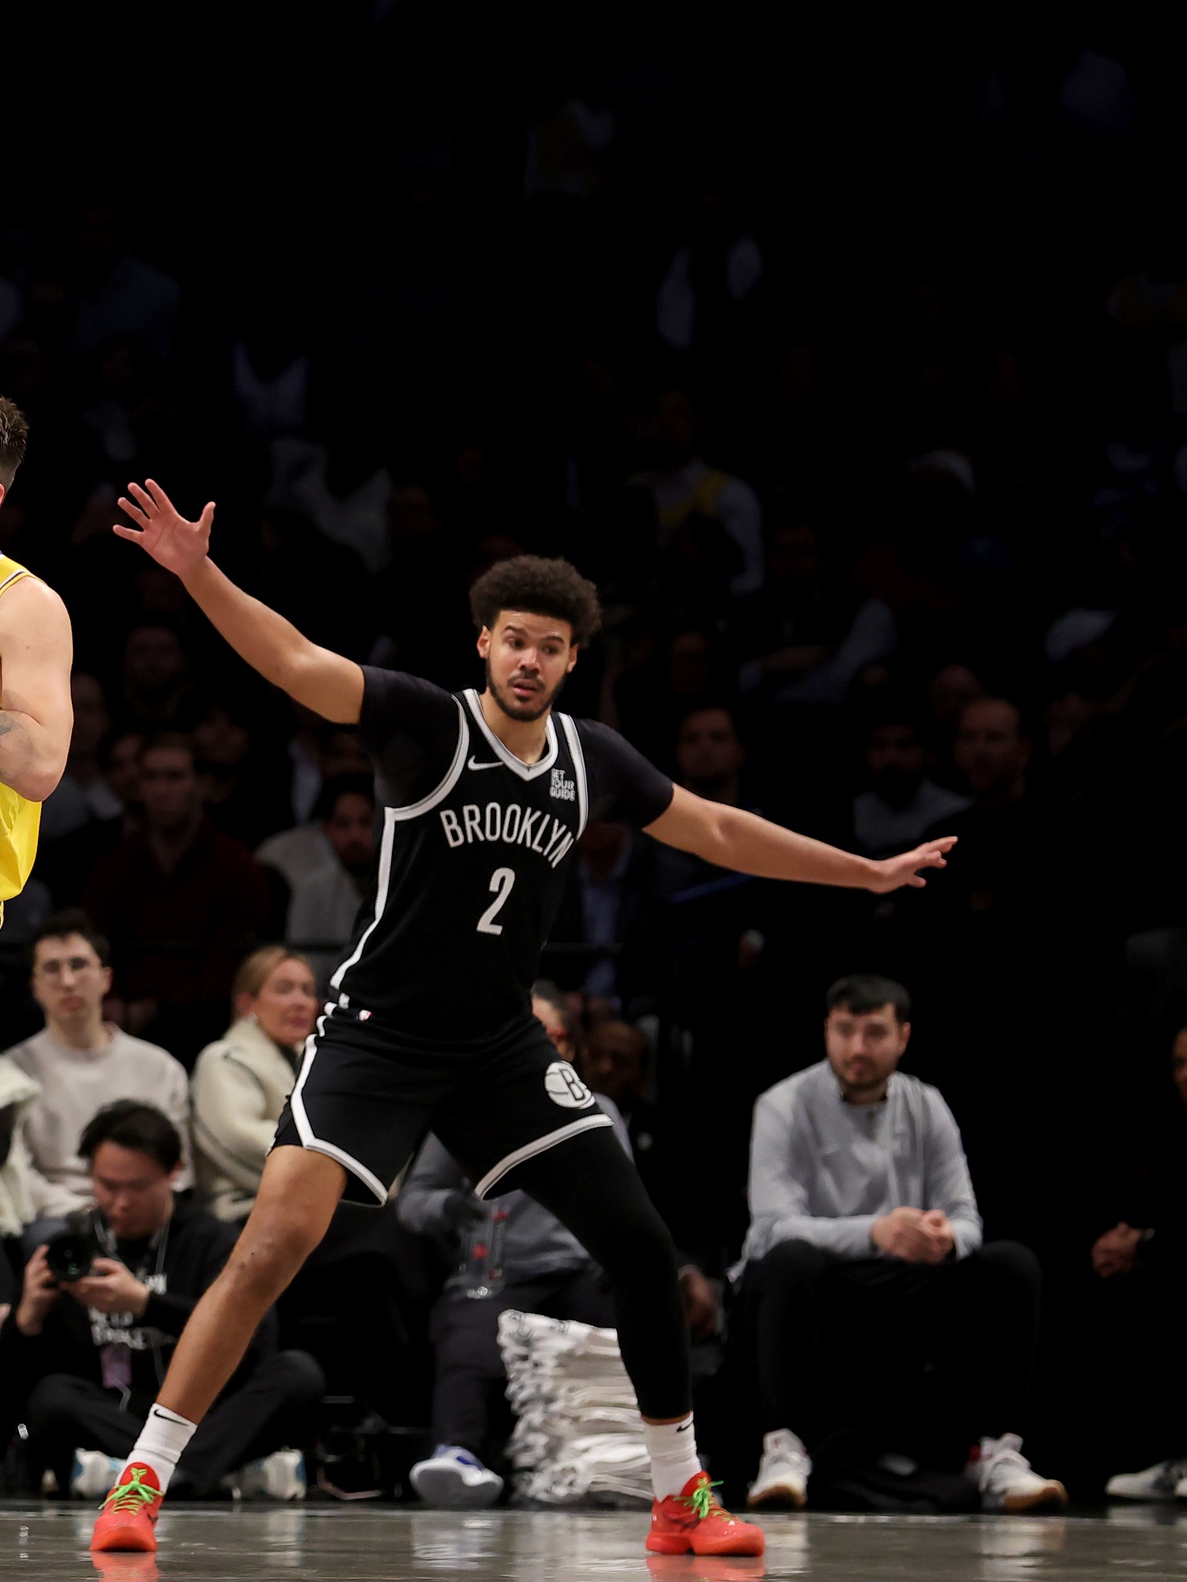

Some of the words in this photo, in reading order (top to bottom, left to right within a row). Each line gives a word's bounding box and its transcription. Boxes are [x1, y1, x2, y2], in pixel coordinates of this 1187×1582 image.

[551, 768, 565, 779] GET
[551, 778, 574, 789] YOUR
[549, 787, 576, 801] GUIDE
[440, 802, 574, 868] BROOKLYN
[476, 867, 515, 935] 2
